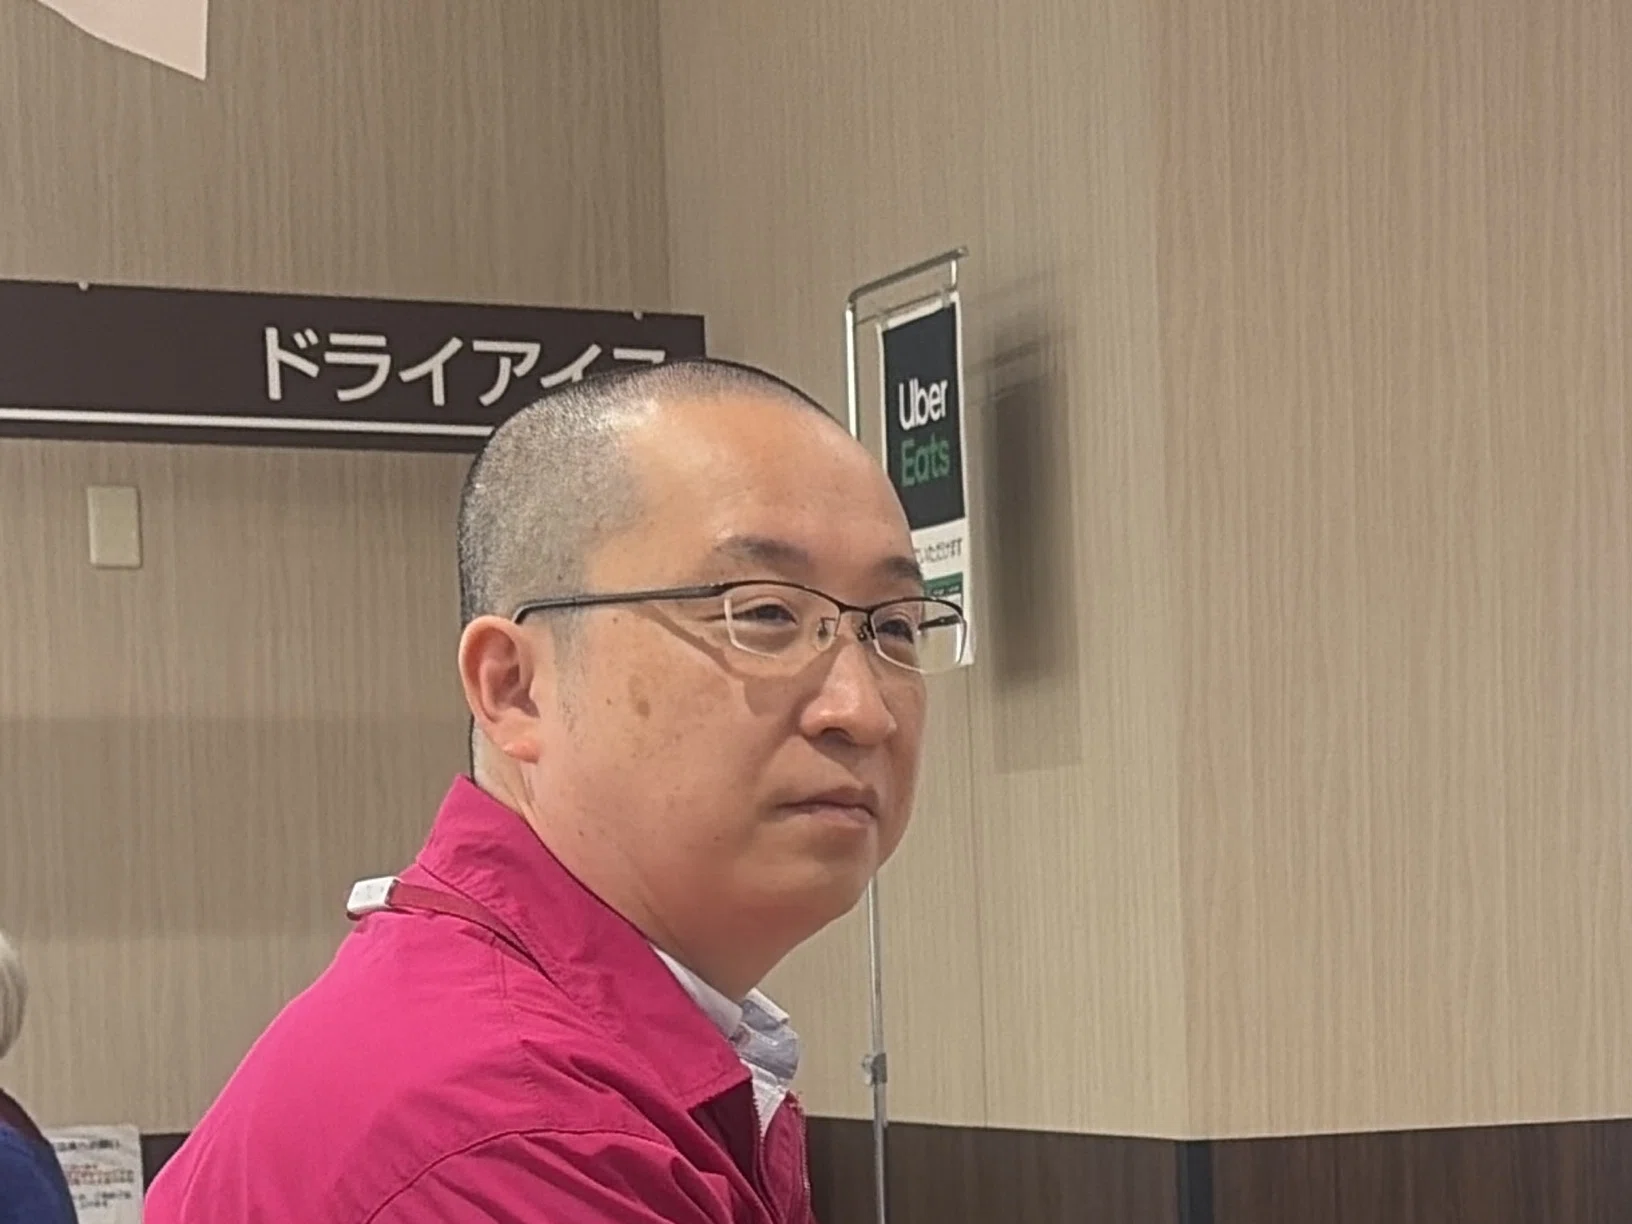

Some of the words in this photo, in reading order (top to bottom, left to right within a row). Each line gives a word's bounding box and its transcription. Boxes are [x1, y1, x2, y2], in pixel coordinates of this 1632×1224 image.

[265, 326, 667, 407] ドライアイ
[898, 378, 948, 430] Uber
[901, 432, 950, 487] Eats
